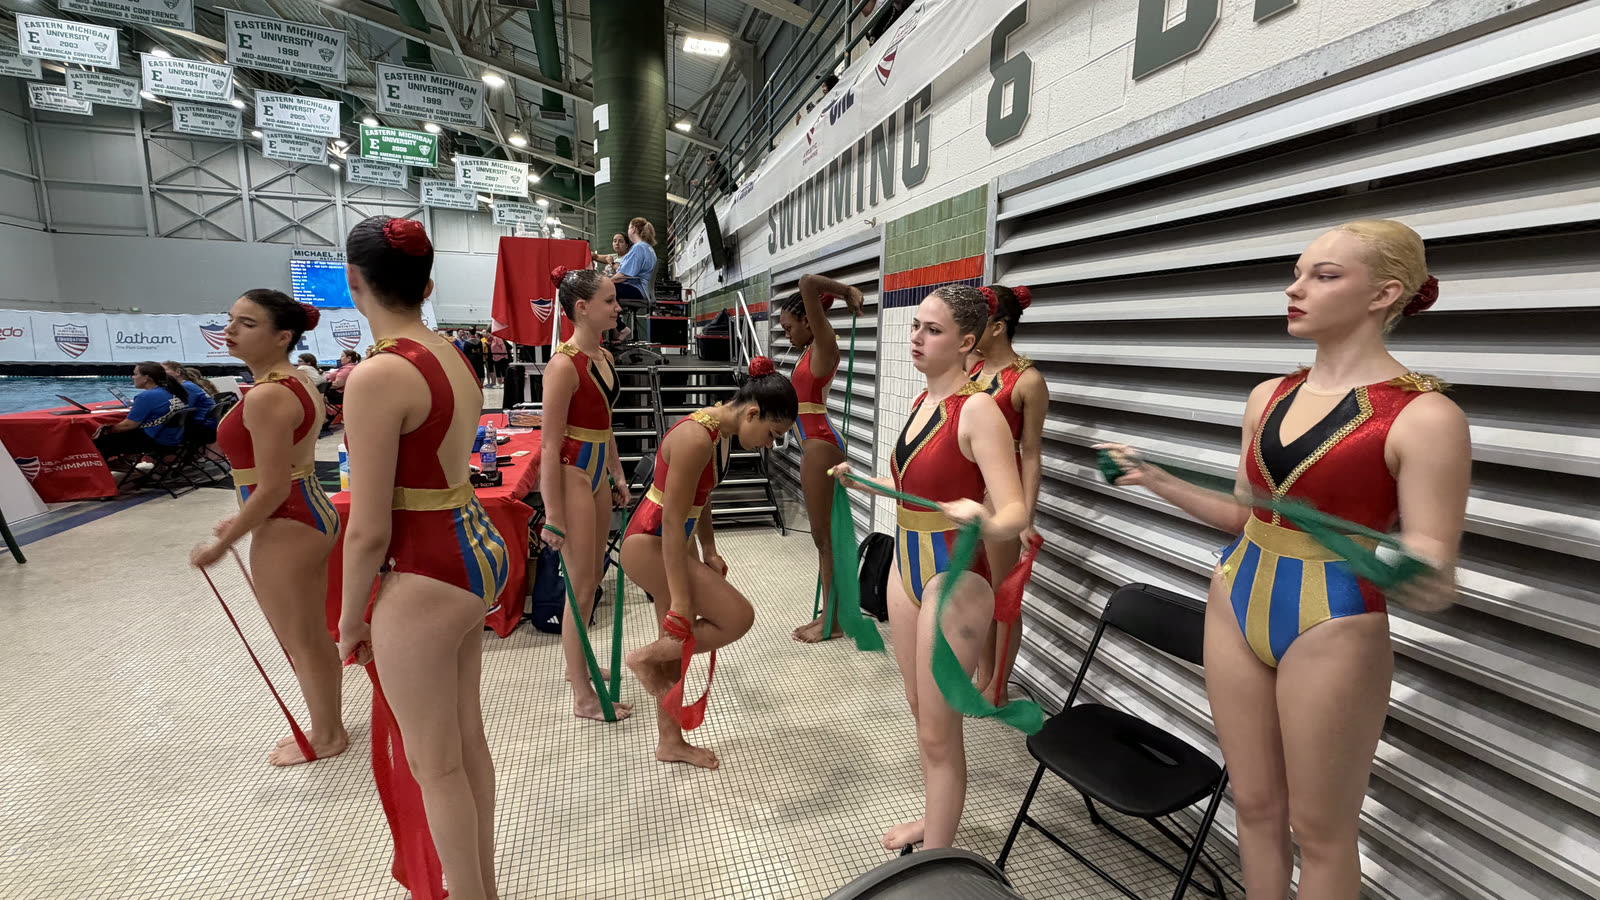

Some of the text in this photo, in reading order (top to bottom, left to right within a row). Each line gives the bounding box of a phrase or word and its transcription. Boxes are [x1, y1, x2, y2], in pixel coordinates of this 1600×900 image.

[133, 7, 178, 20] CONFERENCE
[28, 31, 40, 44] E
[47, 30, 90, 41] UNIVERSITY
[68, 25, 110, 40] MICHIGAN
[234, 21, 338, 46] EASTERN MICHIGAN
[60, 41, 78, 49] 2003
[238, 33, 252, 50] E
[261, 31, 313, 47] UNIVERSITY
[32, 46, 72, 55] MID-AMERICAN
[277, 47, 299, 57] 1998
[242, 52, 333, 72] MID-AMERICAN CONFERENCE
[151, 70, 163, 82] E
[169, 69, 208, 79] UNIVERSITY
[188, 64, 226, 78] MICHIGAN
[255, 61, 283, 71] SWIMMING
[309, 70, 338, 79] CHAMPIONS
[73, 81, 82, 90] E
[103, 76, 135, 87] MICHIGAN
[384, 73, 477, 94] EASTERN MICHIGAN
[155, 84, 191, 92] MID-AMERICAN
[387, 84, 399, 100] E
[408, 82, 454, 96] UNIVERSITY
[297, 99, 333, 112] MICHIGAN
[422, 97, 441, 105] 1999
[208, 109, 237, 119] MICHIGAN
[263, 105, 273, 116] E
[279, 104, 316, 113] UNIVERSITY
[390, 102, 472, 118] MID-AMERICAN CONFERENCE
[180, 114, 188, 122] E
[402, 110, 427, 118] SWIMMING
[450, 117, 476, 125] CHAMPIONS
[370, 138, 379, 149] E
[381, 136, 415, 145] UNIVERSITY
[399, 131, 432, 144] MICHIGAN
[269, 140, 276, 149] E
[463, 168, 471, 179] E
[492, 162, 522, 173] MICHIGAN
[768, 83, 932, 254] SWIMMING
[116, 331, 176, 343] latham
[62, 453, 99, 461] ARTISTIC
[41, 460, 103, 473] SWIMMING
